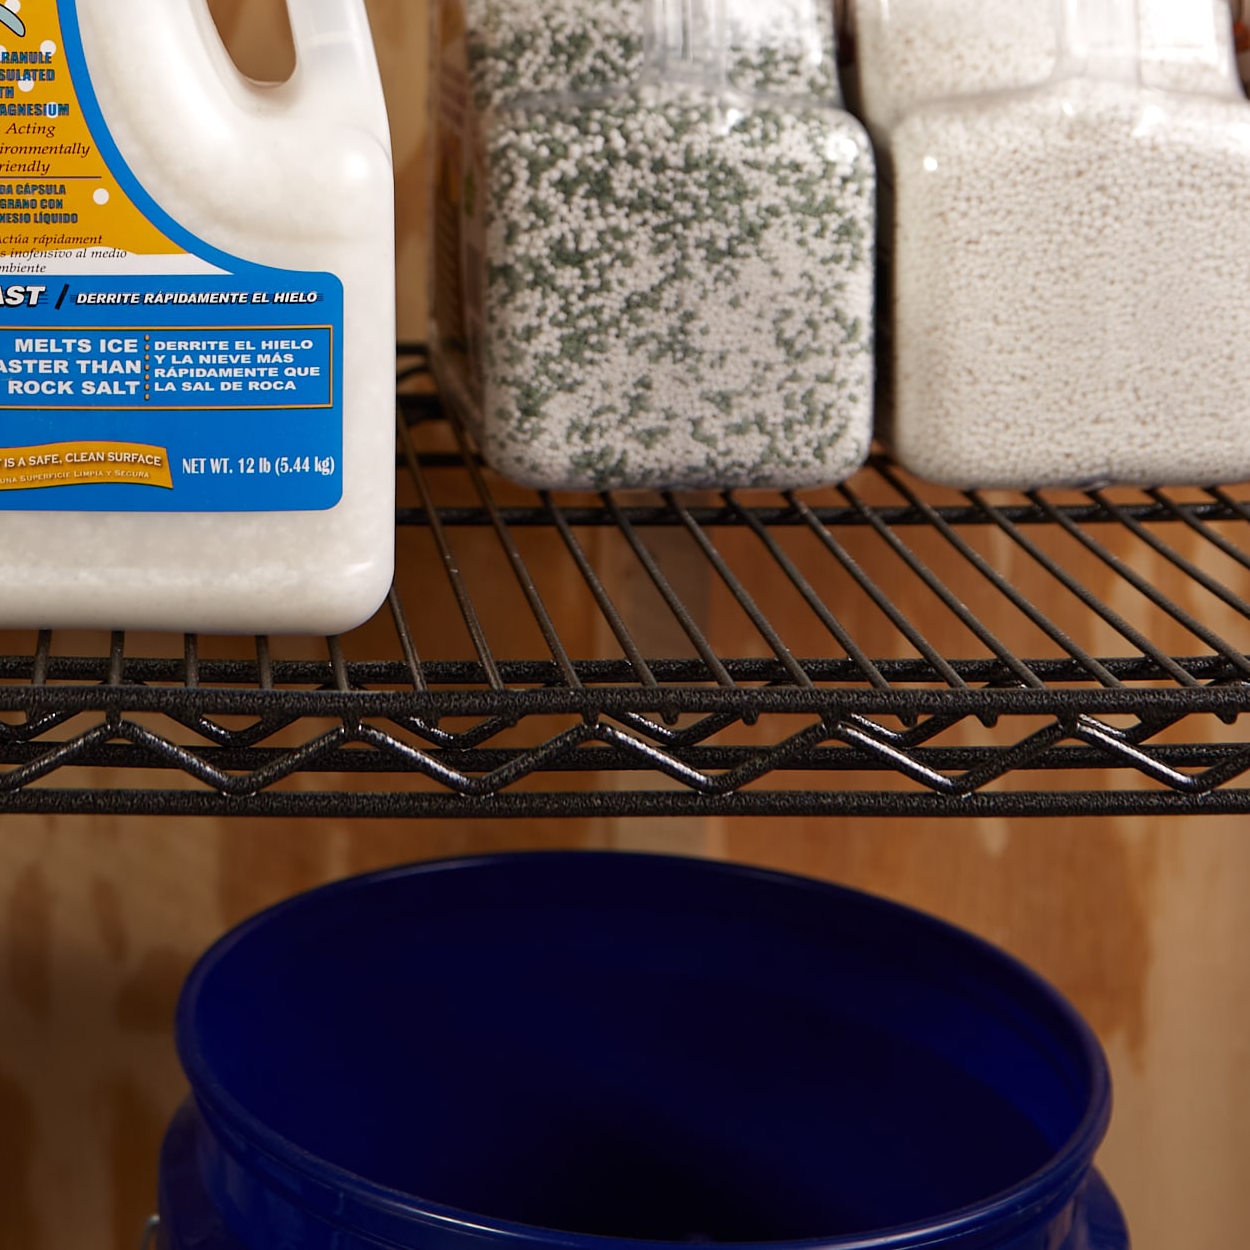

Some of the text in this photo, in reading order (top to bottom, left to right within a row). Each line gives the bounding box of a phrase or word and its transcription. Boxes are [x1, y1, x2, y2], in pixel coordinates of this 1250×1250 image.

[5, 122, 56, 138] Acting
[16, 182, 66, 195] CÁPSULA
[0, 199, 37, 209] GRANO
[40, 199, 63, 209] CON
[34, 211, 78, 224] LÍQUIDO
[33, 234, 102, 247] rápidament
[10, 248, 72, 261] inofensivo
[76, 248, 86, 258] al
[91, 248, 127, 258] medio
[76, 292, 139, 304] DERRITE
[143, 290, 248, 304] RÁPIDAMENTE
[251, 292, 269, 303] EL
[273, 291, 317, 303] HIELO
[15, 339, 138, 353] MELTS ICE
[154, 339, 313, 351] DERRITE EL HIELO
[154, 352, 294, 364] Y LA NIEVE MÁS
[76, 360, 141, 374] THAN
[154, 366, 320, 378] RÁPIDAMENTE QUE
[8, 380, 140, 395] ROCK SALT
[154, 380, 296, 391] LA SAL DE ROCA
[4, 457, 15, 468] IS
[17, 456, 26, 467] A
[28, 454, 62, 466] SAFE,
[65, 452, 105, 463] CLEAN
[107, 452, 162, 467] SURFACE
[182, 456, 335, 476] NET WT. 12 lb (5.44 kg)
[0, 476, 18, 484] UNA
